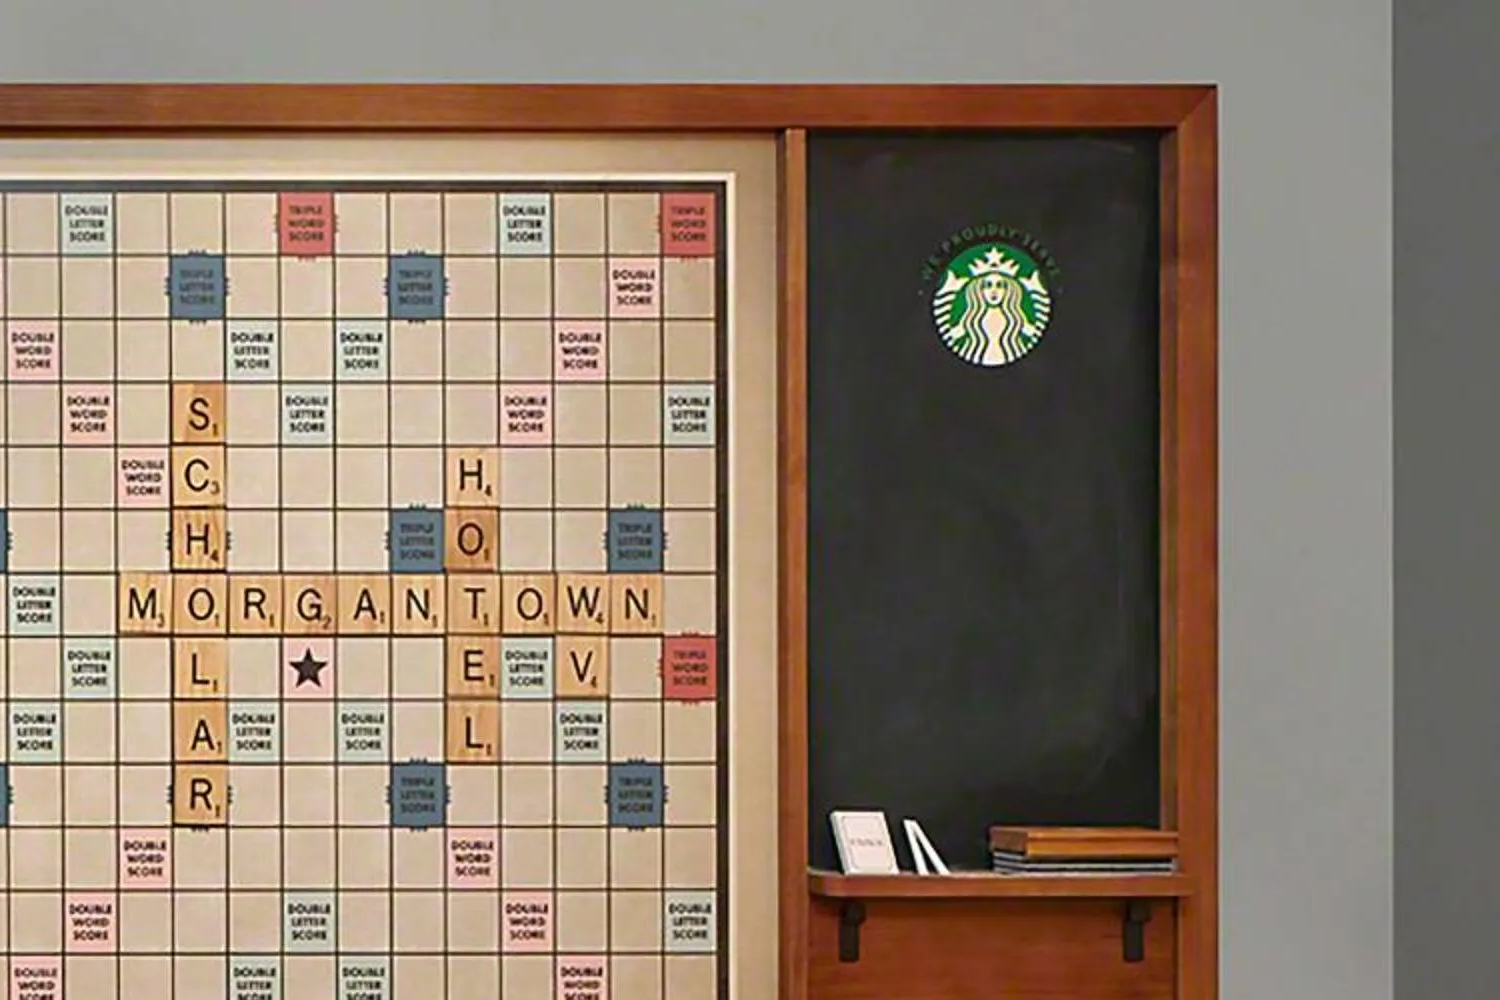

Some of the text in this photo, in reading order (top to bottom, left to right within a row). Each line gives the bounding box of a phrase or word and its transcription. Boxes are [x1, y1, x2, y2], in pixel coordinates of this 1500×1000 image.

[65, 204, 109, 217] DOUBLE
[502, 205, 546, 217] DOUBLE
[68, 218, 105, 229] LETTER
[506, 219, 543, 230] LETTER
[69, 230, 106, 243] SCORE
[507, 231, 543, 243] SCORE
[612, 269, 656, 281] DOUBLE
[615, 282, 654, 293] WORD
[616, 295, 653, 306] SCORE
[11, 331, 55, 344] DOUBLE
[230, 331, 275, 343] DOUBLE
[339, 331, 384, 344] DOUBLE
[558, 332, 602, 344] DOUBLE
[14, 345, 53, 356] WORD
[233, 345, 270, 356] LETTER
[343, 345, 380, 356] LETTER
[561, 345, 600, 356] WORD
[15, 358, 51, 369] SCORE
[233, 358, 270, 370] SCORE
[343, 358, 380, 370] SCORE
[562, 358, 599, 370] SCORE
[66, 395, 110, 407] DOUBLE
[285, 395, 329, 407] DOUBLE
[504, 395, 548, 407] DOUBLE
[667, 396, 711, 407] DOUBLE
[69, 409, 108, 420] WORD
[289, 409, 325, 420] LETTER
[507, 409, 545, 420] WORD
[671, 409, 707, 420] LETTER
[70, 421, 107, 433] SCORE
[289, 421, 326, 433] SCORE
[507, 421, 544, 433] SCORE
[671, 422, 707, 433] SCORE
[121, 459, 165, 471] DOUBLE
[124, 472, 163, 483] WORD
[125, 485, 162, 497] SCORE
[12, 586, 57, 598] DOUBLE
[16, 599, 53, 610] LETTER
[16, 612, 53, 624] SCORE
[67, 650, 112, 662] DOUBLE
[504, 649, 549, 661] DOUBLE
[71, 663, 108, 674] LETTER
[508, 663, 545, 674] LETTER
[71, 676, 108, 687] SCORE
[509, 675, 545, 687] SCORE
[13, 713, 57, 725] DOUBLE
[231, 713, 276, 725] DOUBLE
[341, 713, 385, 725] DOUBLE
[559, 713, 603, 725] DOUBLE
[16, 727, 53, 737] LETTER
[235, 726, 272, 737] LETTER
[344, 726, 381, 737] LETTER
[563, 726, 600, 737] LETTER
[16, 739, 54, 751] SCORE
[235, 739, 272, 751] SCORE
[345, 739, 382, 751] SCORE
[563, 739, 599, 751] SCORE
[123, 840, 167, 852] DOUBLE
[450, 839, 494, 851] DOUBLE
[126, 853, 165, 864] WORD
[454, 853, 492, 864] WORD
[126, 866, 163, 878] SCORE
[454, 865, 491, 877] SCORE
[69, 903, 113, 915] DOUBLE
[287, 903, 331, 915] DOUBLE
[505, 902, 549, 915] DOUBLE
[668, 903, 712, 915] DOUBLE
[72, 917, 110, 928] WORD
[291, 917, 327, 927] LETTER
[509, 916, 547, 927] WORD
[672, 916, 709, 927] LETTER
[72, 929, 109, 941] SCORE
[291, 929, 328, 941] SCORE
[509, 929, 546, 941] SCORE
[672, 929, 708, 940] SCORE
[13, 967, 58, 978] DOUBLE
[233, 967, 277, 978] DOUBLE
[342, 966, 386, 978] DOUBLE
[560, 966, 604, 978] DOUBLE
[17, 980, 56, 991] WORD
[236, 980, 273, 991] LETTER
[345, 980, 382, 991] LETTER
[563, 980, 601, 990] WORD
